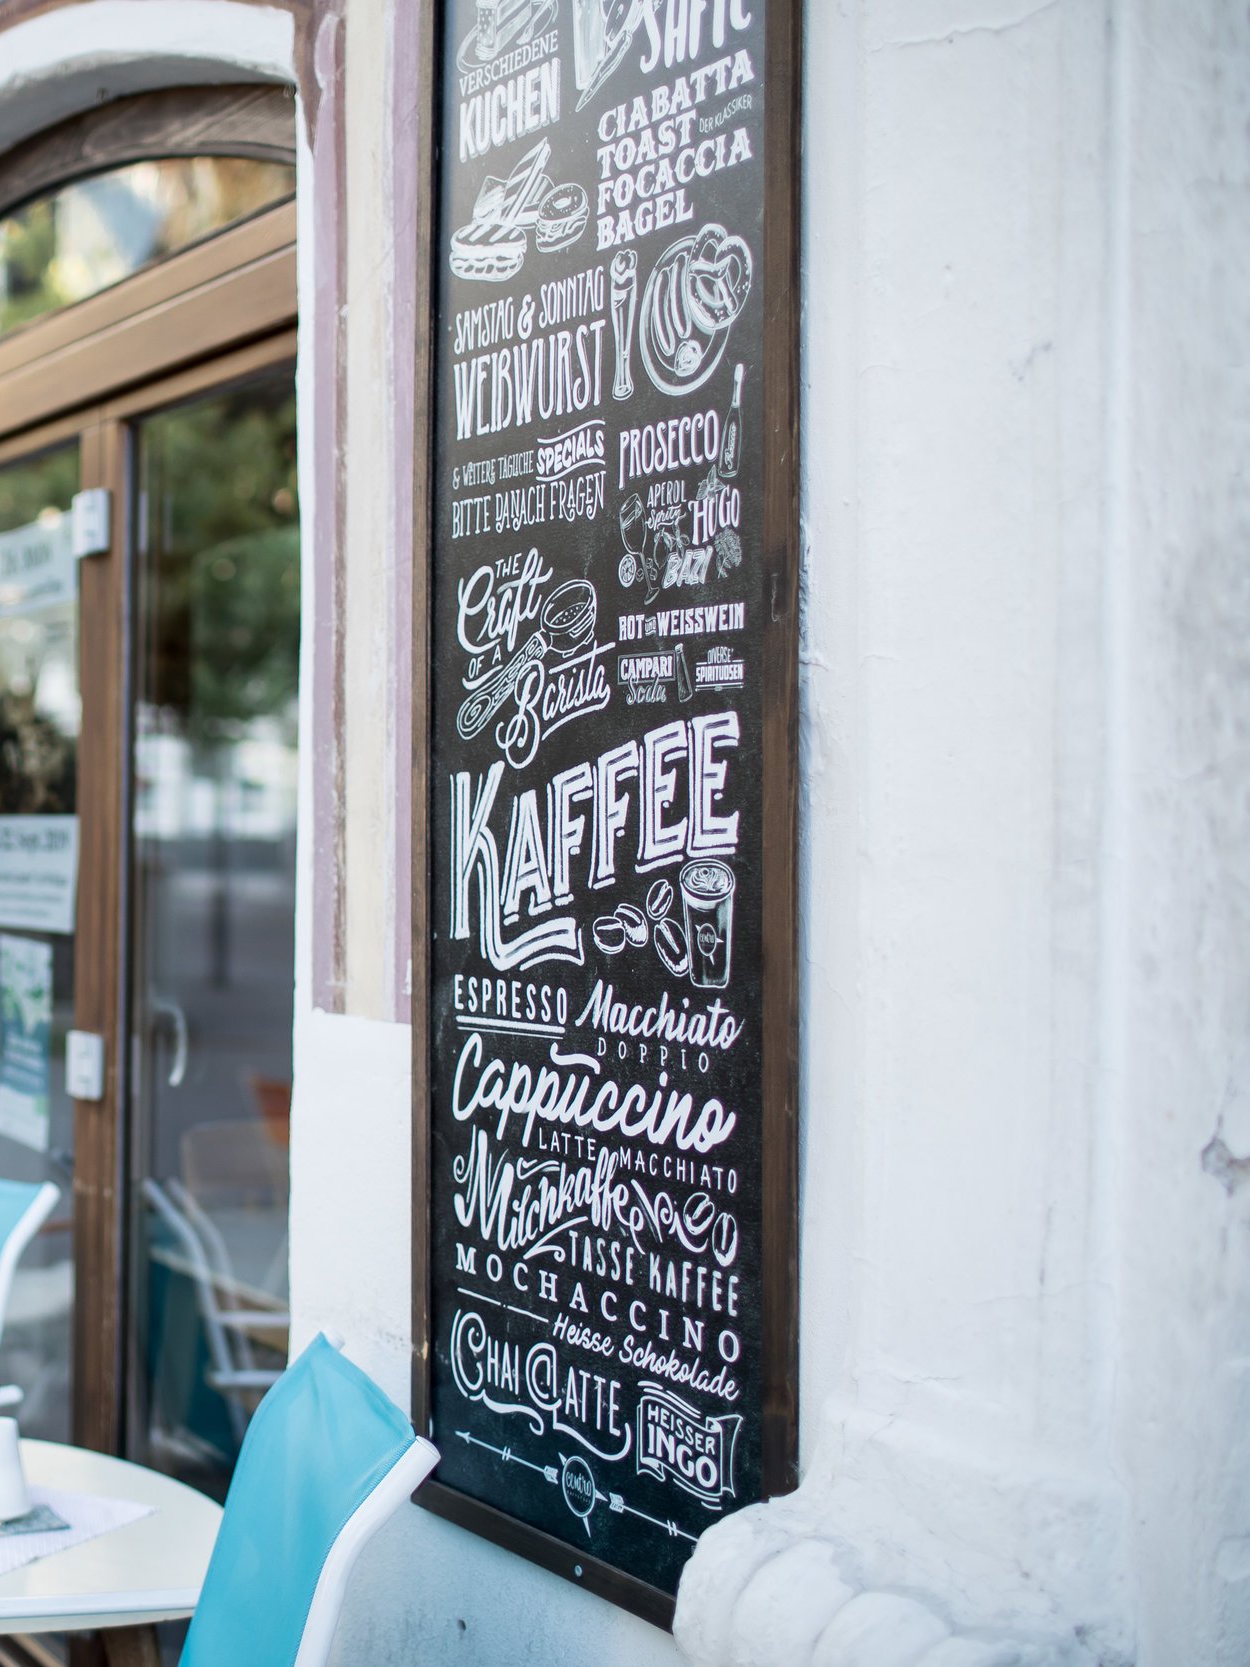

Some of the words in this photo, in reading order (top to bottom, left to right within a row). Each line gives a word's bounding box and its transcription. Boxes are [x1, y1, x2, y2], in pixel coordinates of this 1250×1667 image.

[458, 30, 558, 97] VERSCHIEDENE
[598, 49, 754, 142] CIABATTA
[459, 57, 561, 163] KUCHEN
[699, 116, 713, 133] DER
[714, 94, 753, 127] KLASSIKER
[597, 109, 696, 179] TOAST
[597, 127, 752, 215] FOCACCIA
[596, 188, 693, 250] BAGEL
[454, 297, 513, 354] SAMSTAG
[517, 294, 535, 339] &
[539, 266, 604, 329] SONNTAG
[452, 467, 460, 490] &
[462, 458, 496, 485] WEITERE
[498, 450, 534, 480] TÄGLICHE
[536, 429, 604, 475] SPECIALS
[618, 409, 719, 490] PROSECCO
[452, 495, 491, 539] BITTE
[495, 484, 546, 533] DANACH
[550, 470, 606, 522] FRAGEN
[646, 480, 687, 508] APEROL
[646, 504, 687, 531] Spritz
[688, 485, 741, 545] HUGO
[495, 553, 522, 578] THE
[457, 547, 553, 654] Craft
[618, 614, 645, 641] ROT
[656, 602, 745, 637] WEISSWEIN
[468, 655, 485, 679] OF
[492, 645, 501, 665] A
[620, 656, 673, 683] CAMPARI
[696, 664, 744, 683] SPIRITUOSEN
[495, 640, 616, 769] Barista
[450, 711, 741, 971] KAFFEE
[454, 974, 567, 1025] ESPRESSO
[574, 978, 745, 1050] Macchiato
[597, 1037, 710, 1073] DOPPIO
[452, 1032, 737, 1154] Cappuccino
[538, 1127, 597, 1161] LATTE
[619, 1145, 738, 1195] MACCHIATO
[455, 1242, 740, 1363] MOCHACCINO
[568, 1230, 635, 1286] TASSE
[650, 1252, 740, 1317] KAFFEE
[552, 1312, 616, 1356] Heisse
[619, 1334, 740, 1400] Schokolade
[647, 1403, 716, 1455] HEISSER
[647, 1422, 718, 1489] INGO
